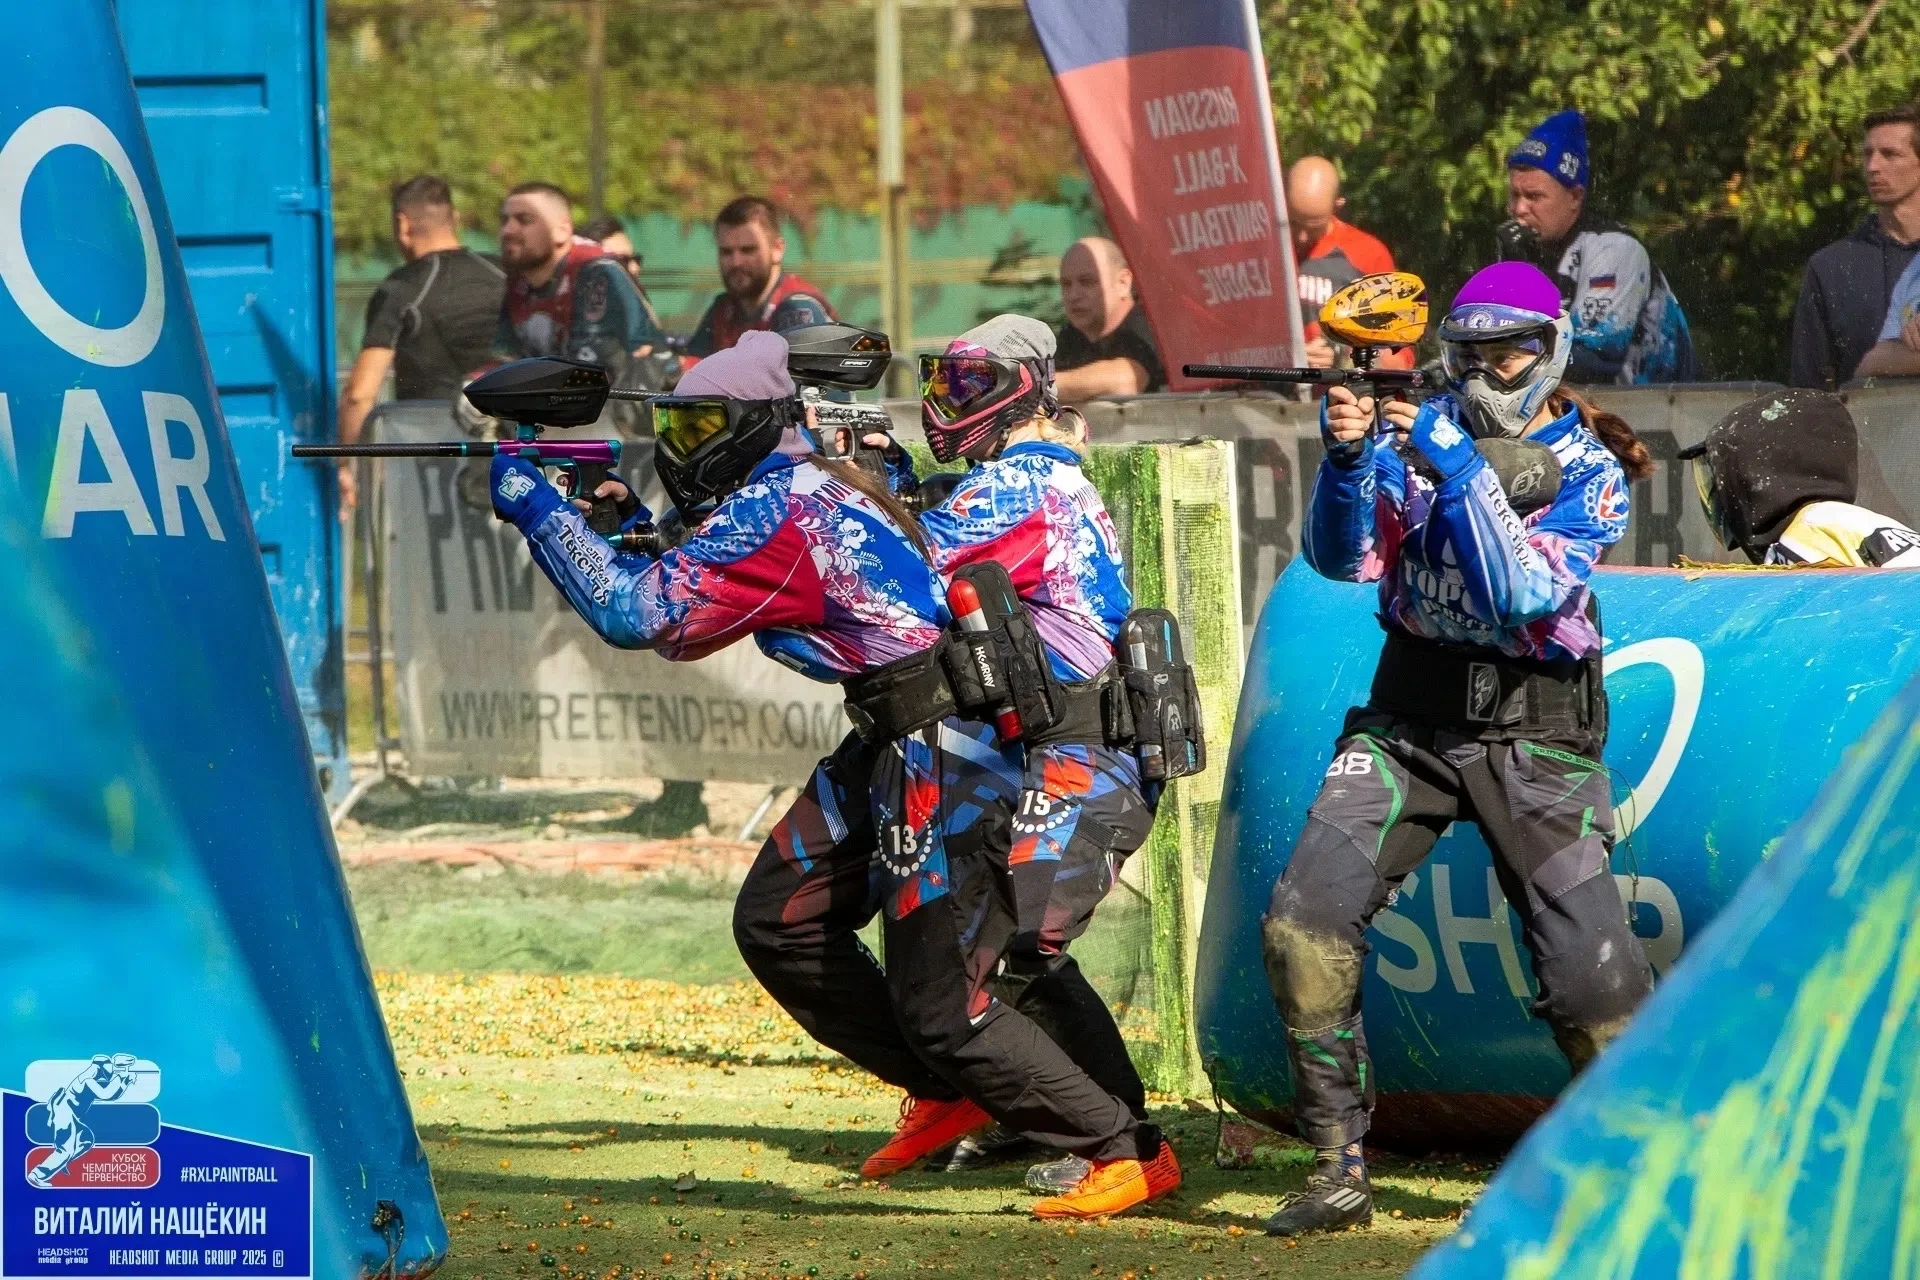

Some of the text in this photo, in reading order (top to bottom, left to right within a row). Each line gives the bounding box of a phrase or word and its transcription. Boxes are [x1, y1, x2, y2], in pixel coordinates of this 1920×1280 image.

[0, 389, 226, 542] AR
[439, 690, 843, 752] WWWPREETENDER.COM
[1022, 790, 1051, 816] 15
[890, 824, 918, 855] 13
[1372, 864, 1684, 998] SHR
